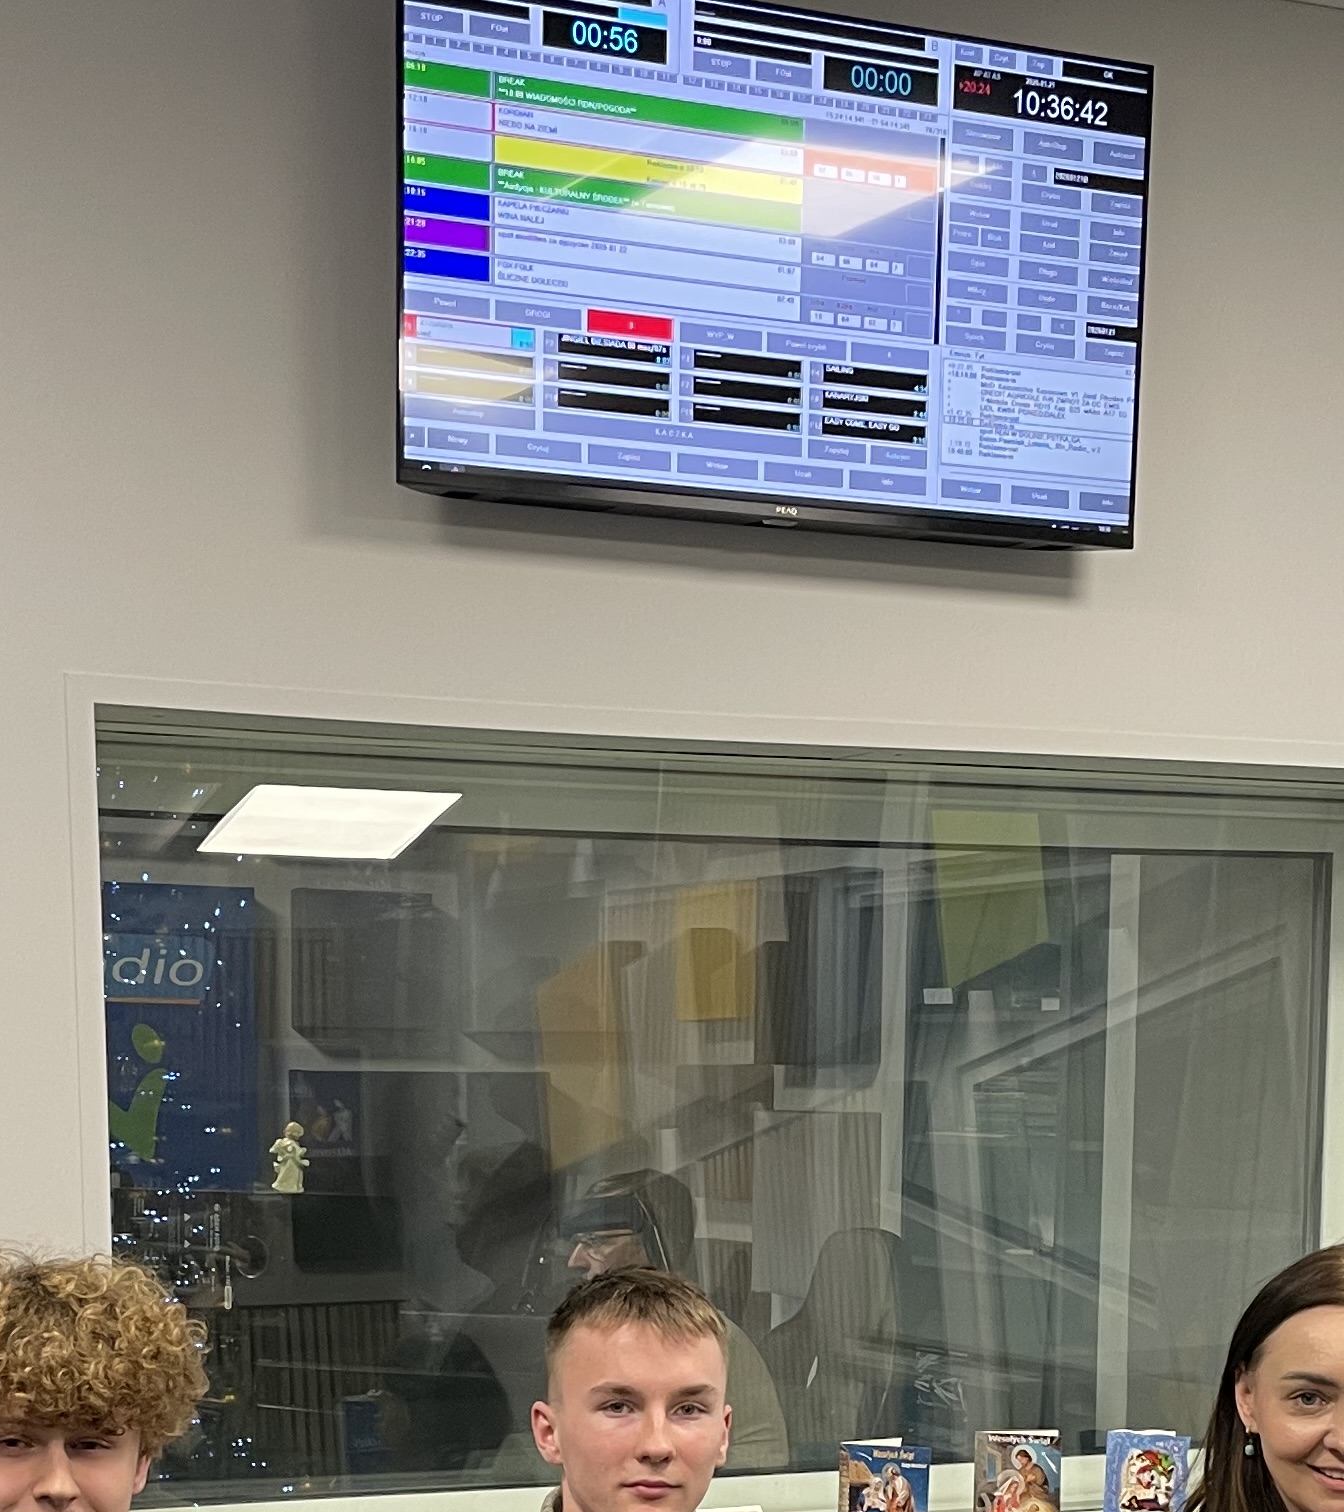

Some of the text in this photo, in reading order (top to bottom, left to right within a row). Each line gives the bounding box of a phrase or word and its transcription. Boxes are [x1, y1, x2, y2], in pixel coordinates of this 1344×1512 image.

[420, 12, 444, 22] STOP
[572, 20, 638, 54] 00:56
[498, 75, 526, 86] BREAK
[851, 64, 912, 96] 00:00
[1103, 71, 1114, 80] OK
[1013, 88, 1108, 126] 10:36:42
[498, 168, 525, 179] BREAK
[824, 416, 844, 426] EASY
[868, 421, 887, 430] EASY
[655, 428, 694, 439] KACZKA
[112, 948, 204, 987] dio
